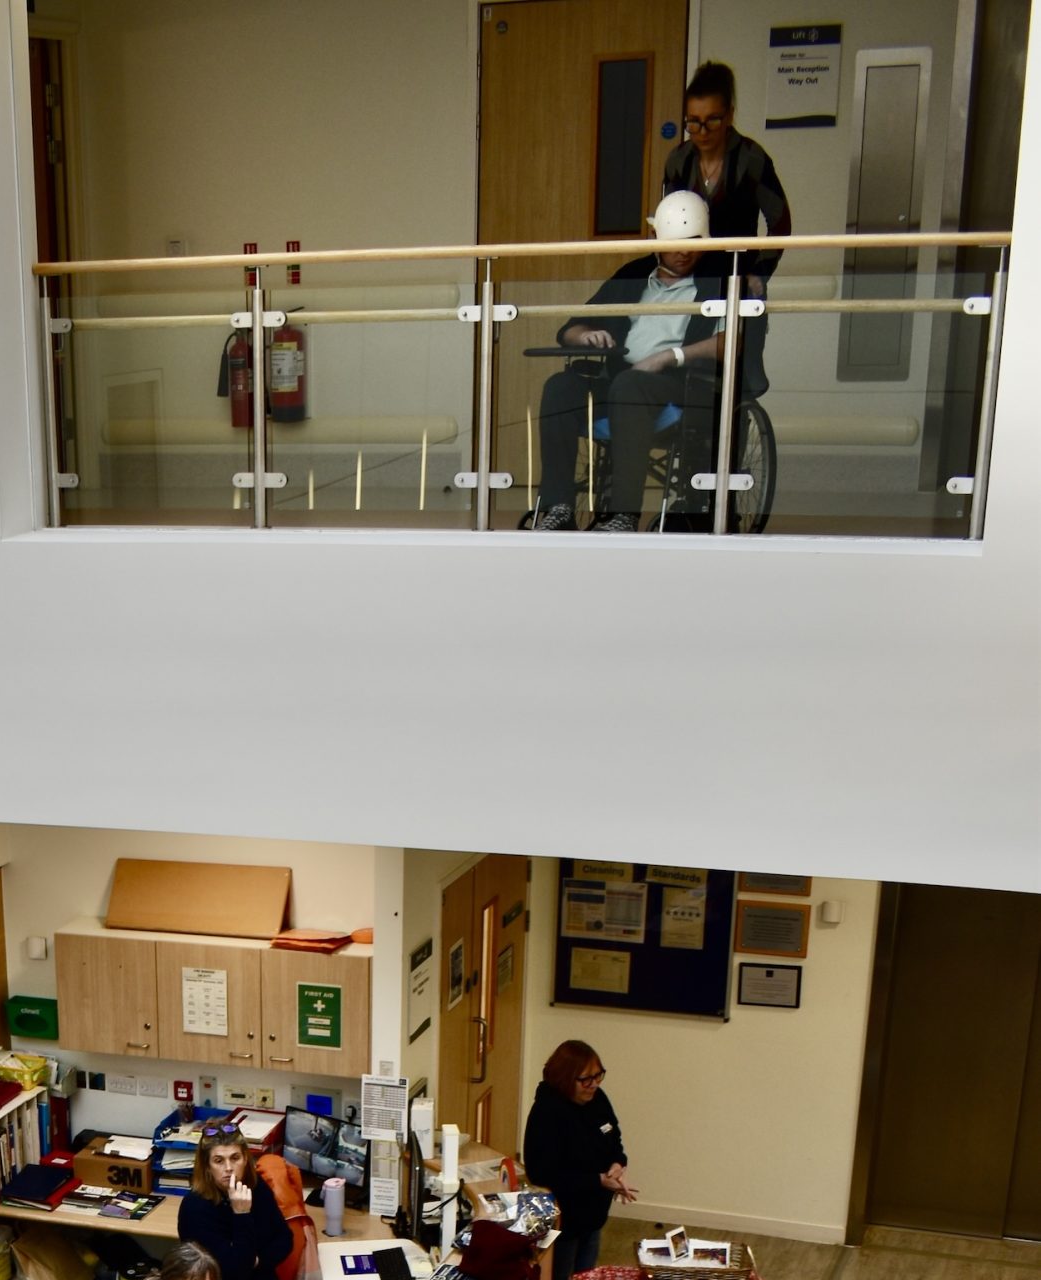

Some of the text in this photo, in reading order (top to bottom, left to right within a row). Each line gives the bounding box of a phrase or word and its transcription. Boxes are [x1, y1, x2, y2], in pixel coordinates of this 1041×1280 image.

[777, 65, 830, 74] Main Reception
[788, 78, 803, 86] Way
[582, 865, 624, 877] Cleaning
[652, 869, 702, 883] Standards
[107, 1165, 142, 1188] 3M
